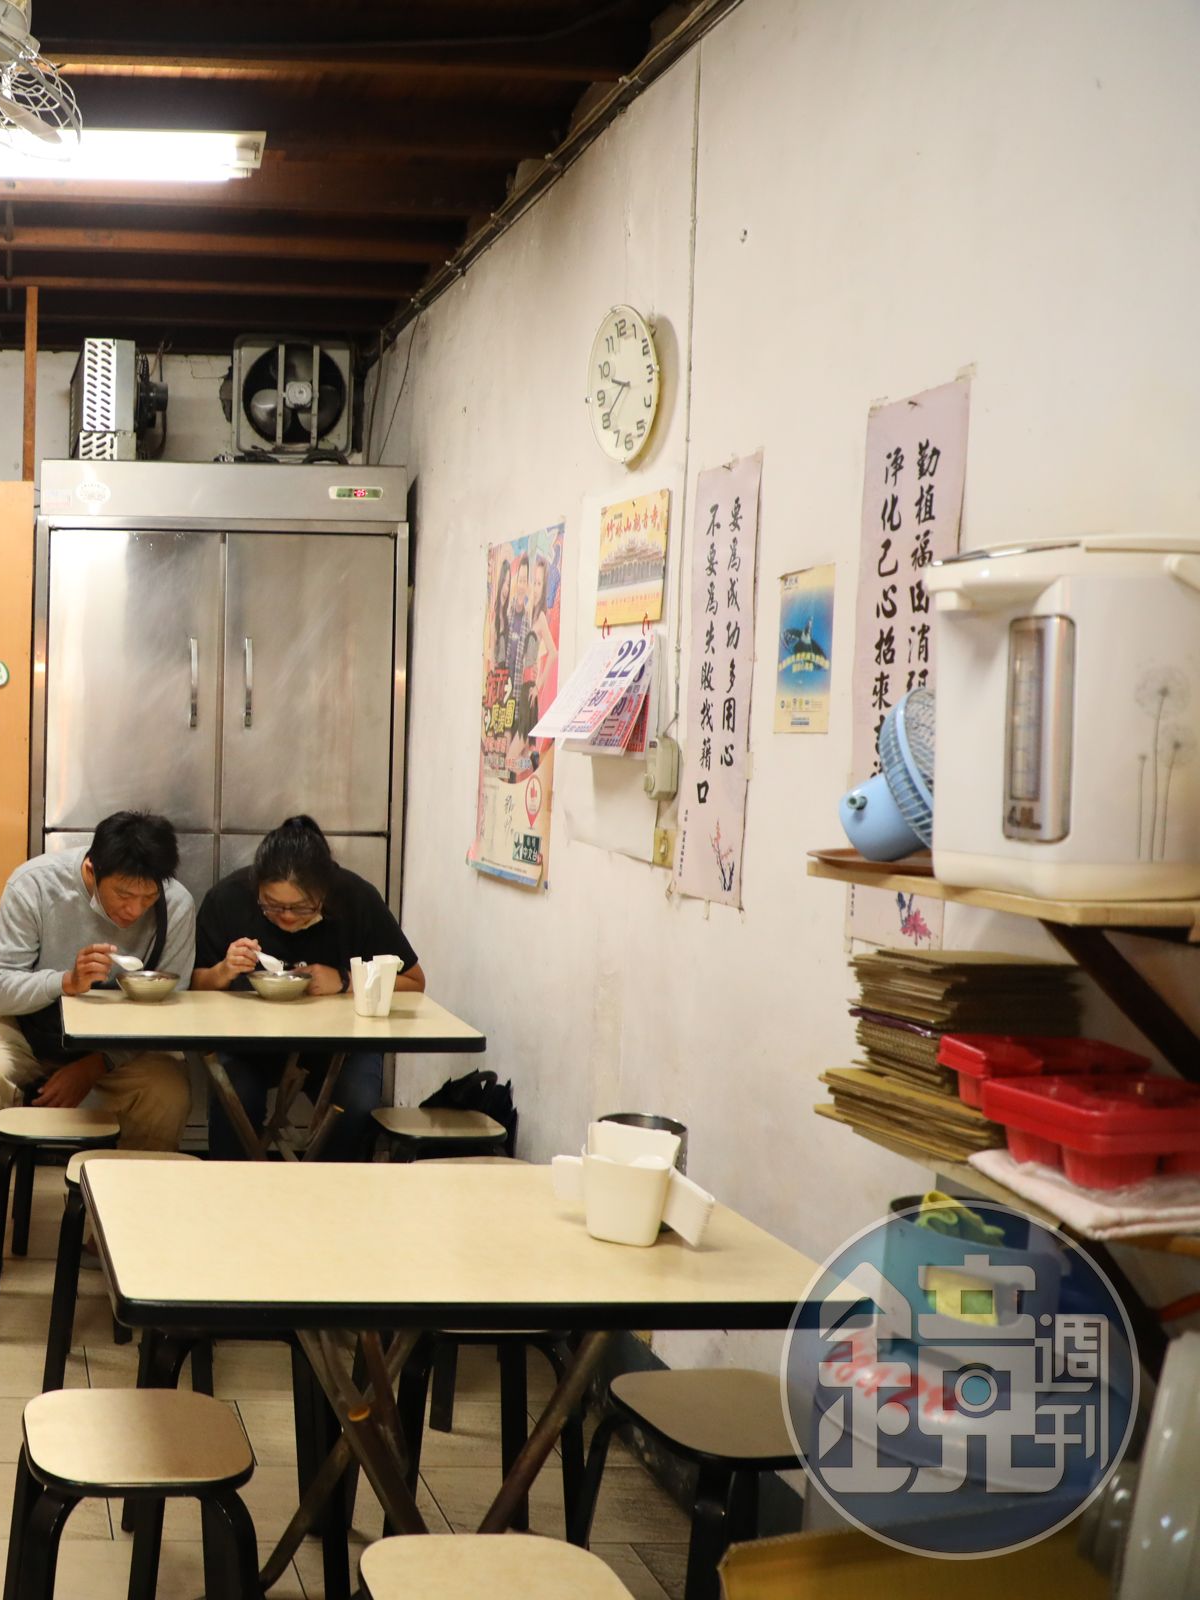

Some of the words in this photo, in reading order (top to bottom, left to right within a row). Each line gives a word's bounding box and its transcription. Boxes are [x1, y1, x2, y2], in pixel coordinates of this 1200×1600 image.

[615, 320, 627, 338] 12
[632, 323, 637, 339] 1
[605, 336, 615, 353] 11
[642, 338, 650, 356] 2
[598, 361, 610, 379] 10
[596, 390, 606, 407] 9
[602, 413, 612, 430] 8
[636, 419, 646, 437] 5
[613, 430, 621, 447] 7
[624, 433, 634, 451] 6
[606, 639, 647, 678] 22
